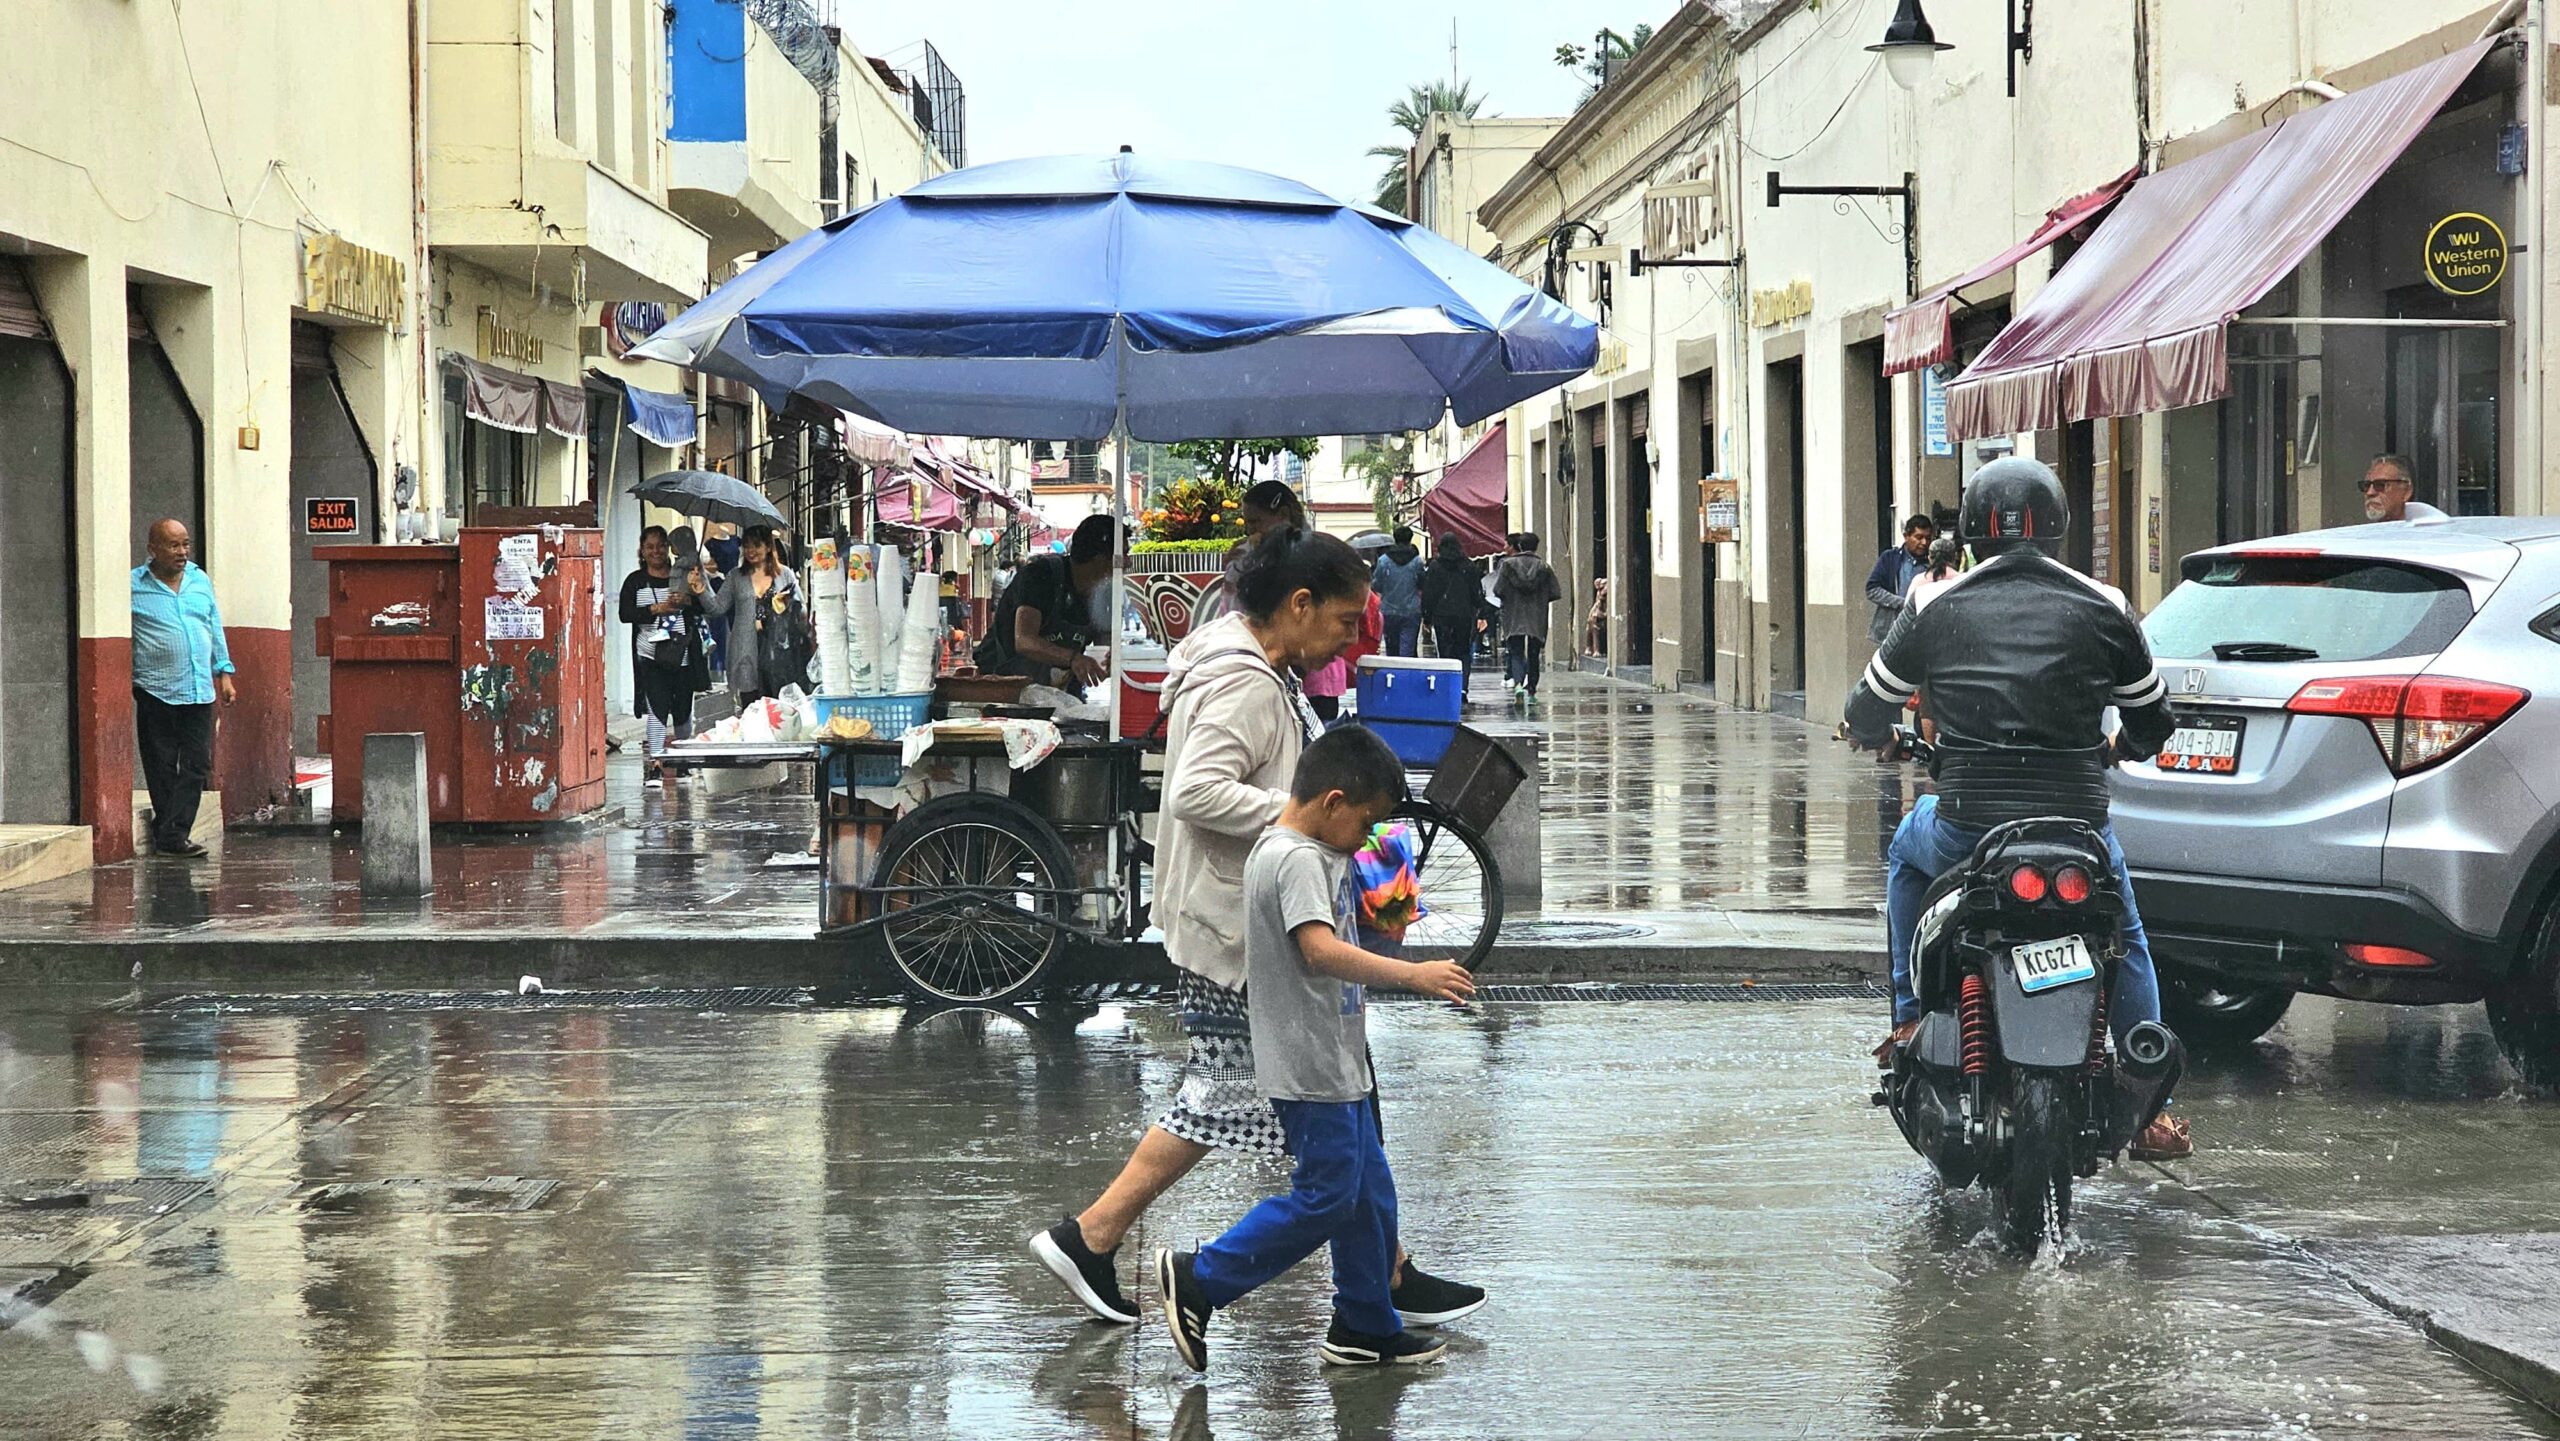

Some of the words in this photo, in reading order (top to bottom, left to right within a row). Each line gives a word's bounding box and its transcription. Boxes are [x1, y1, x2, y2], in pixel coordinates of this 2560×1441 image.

[2450, 232, 2480, 246] WU
[2434, 247, 2500, 264] Western
[2446, 263, 2491, 278] Union
[317, 503, 346, 515] EXIT
[310, 517, 355, 529] SALIDA
[2023, 944, 2077, 976] KCG27
